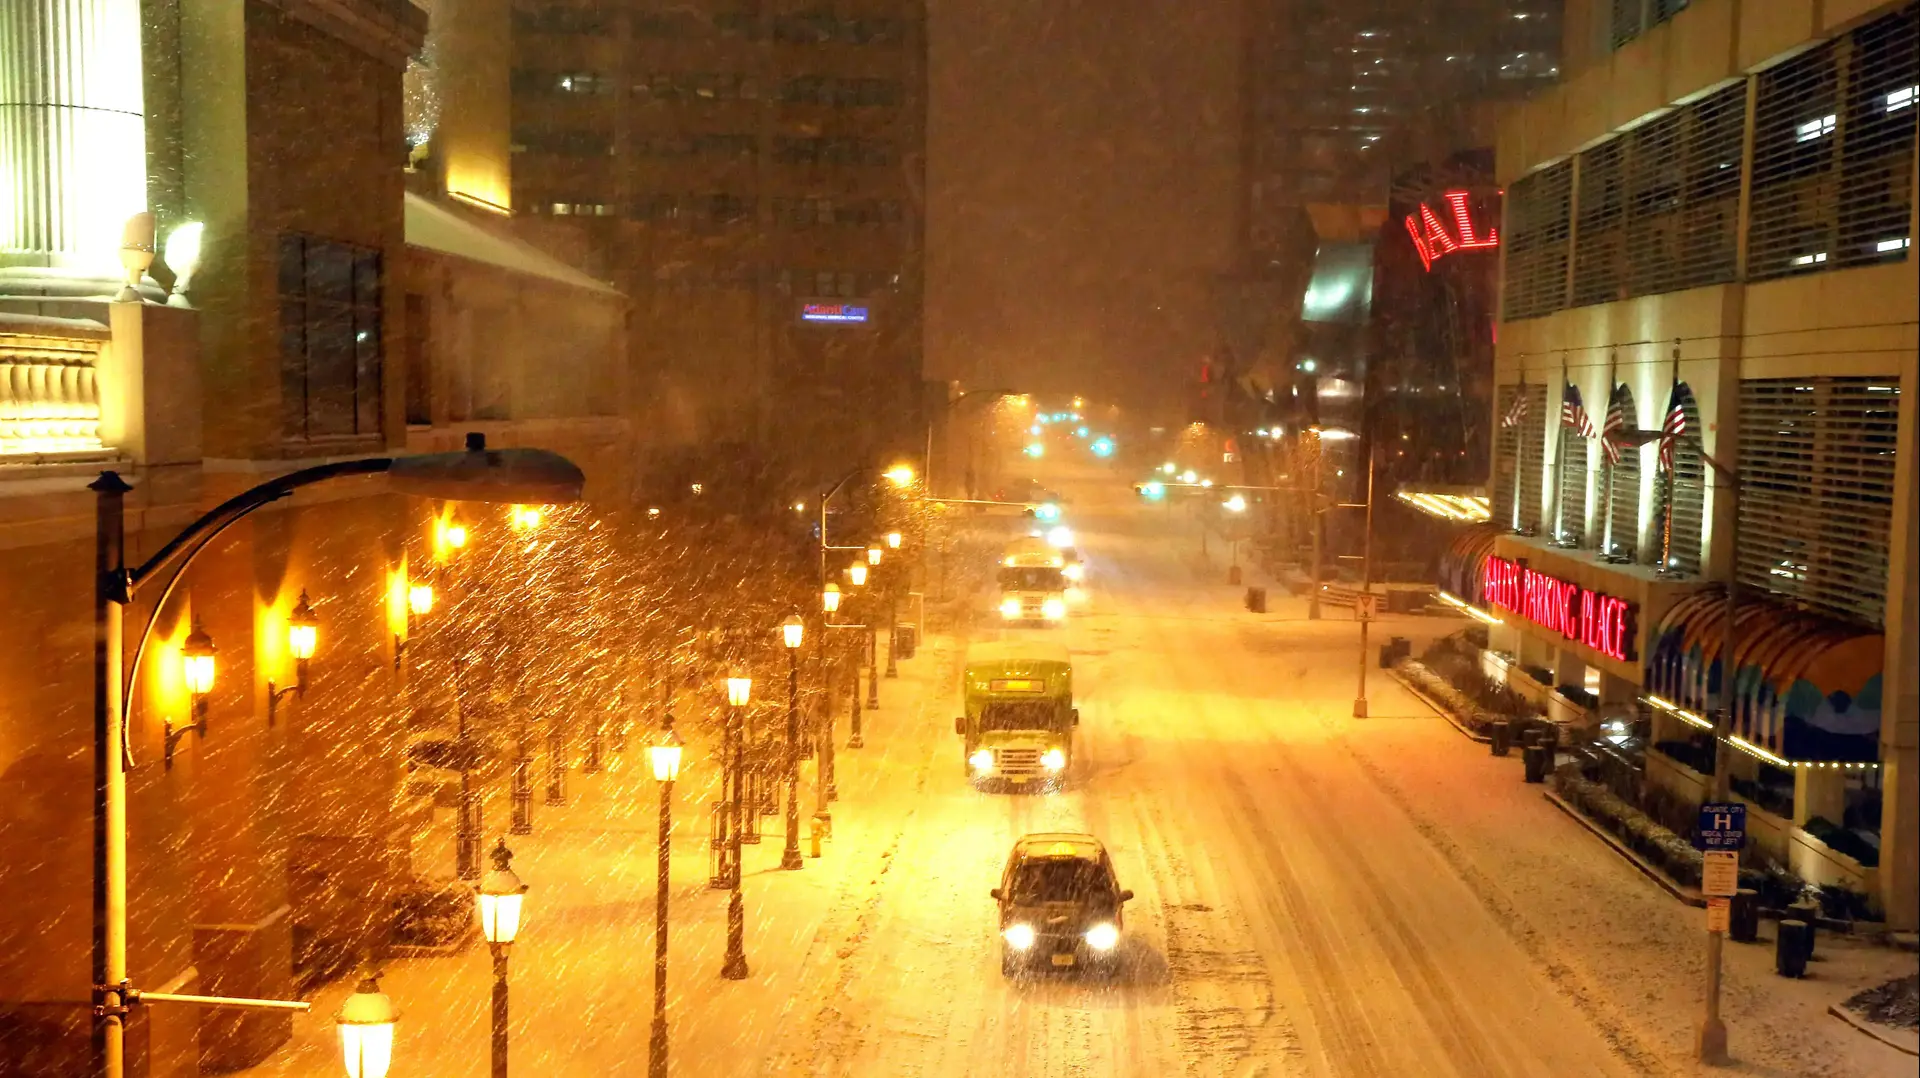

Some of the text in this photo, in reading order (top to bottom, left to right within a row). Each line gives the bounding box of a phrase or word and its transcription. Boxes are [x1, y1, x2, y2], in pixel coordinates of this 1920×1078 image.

[1405, 189, 1504, 272] BAL
[1523, 568, 1576, 640] PARKING
[1581, 589, 1628, 662] PLACE
[975, 681, 988, 690] 72
[1703, 805, 1728, 813] ATLANTIC
[1714, 813, 1731, 830] H
[1701, 830, 1721, 838] MEDICAL
[1705, 837, 1737, 845] NEXT LEFT
